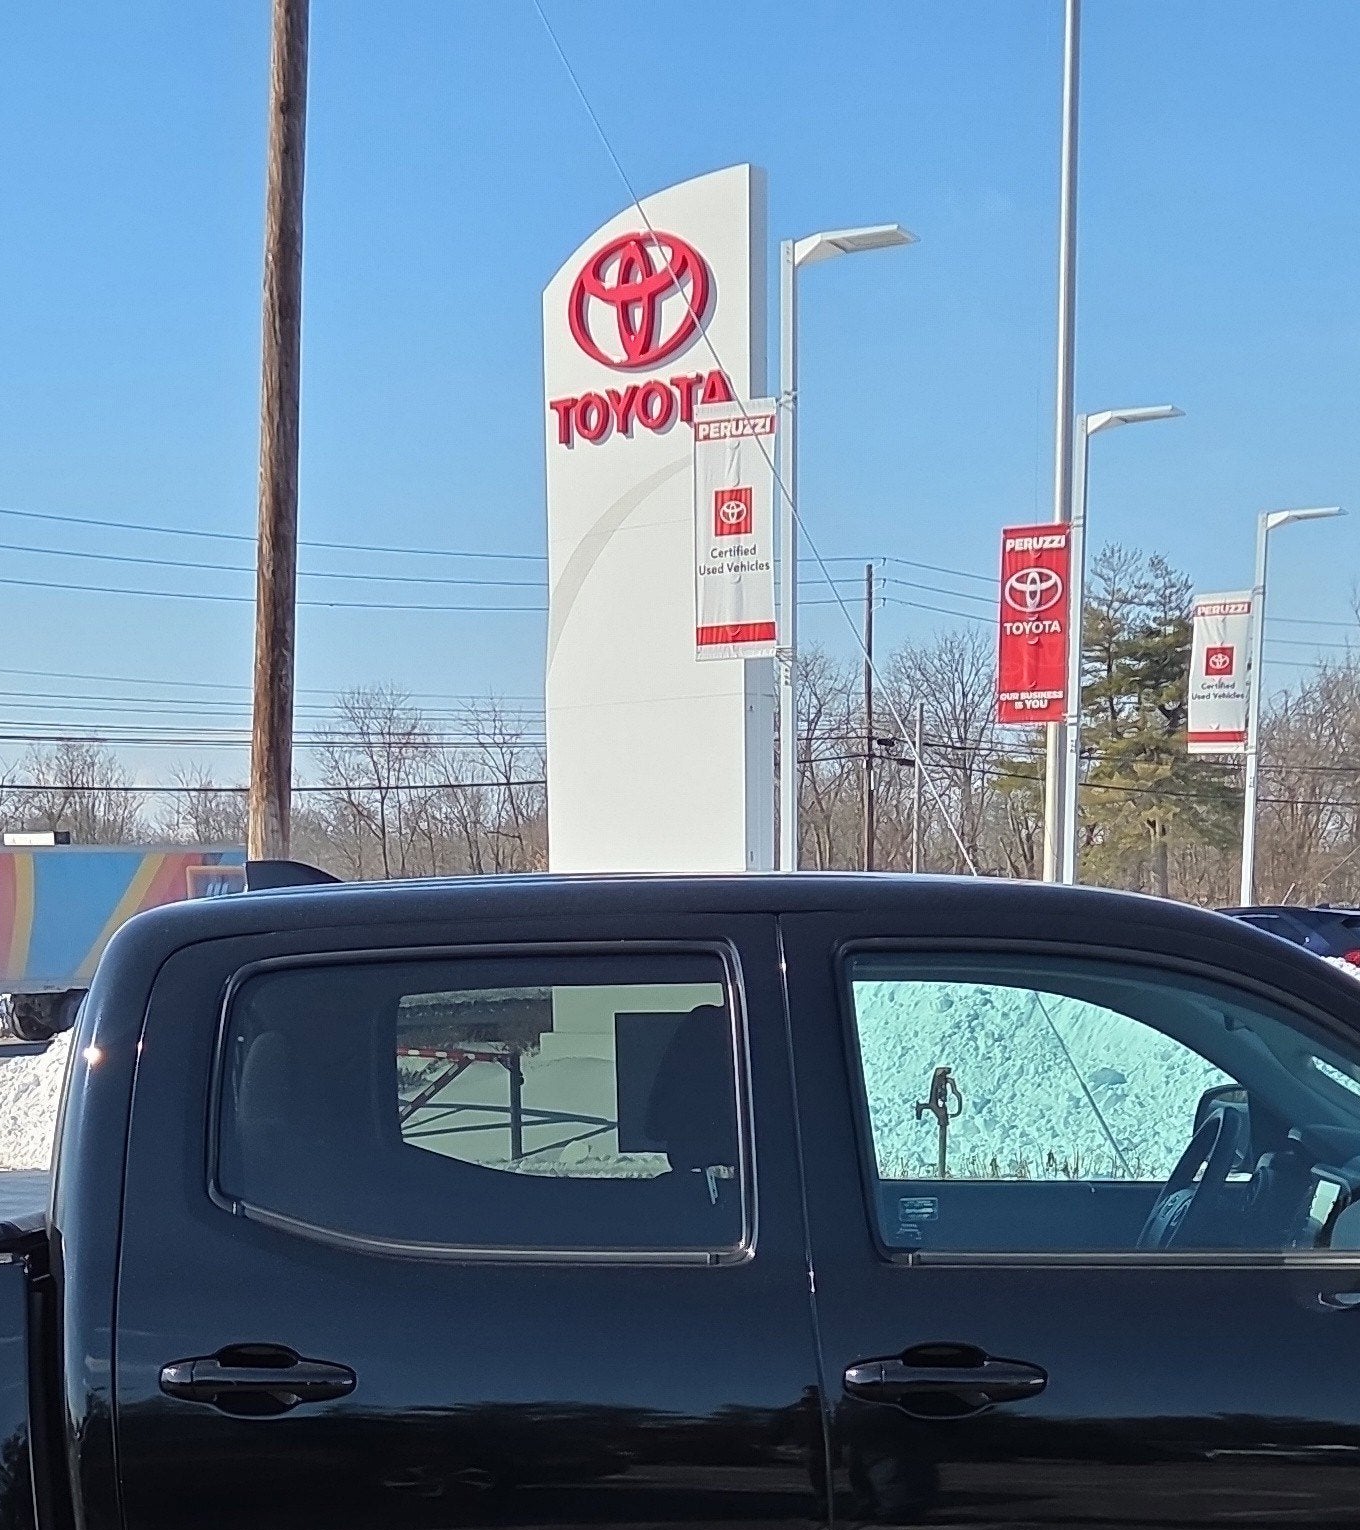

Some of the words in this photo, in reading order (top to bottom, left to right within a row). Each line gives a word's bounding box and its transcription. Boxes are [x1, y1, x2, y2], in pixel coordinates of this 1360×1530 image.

[550, 370, 734, 445] TOYOTA
[698, 416, 772, 441] PERUZZI
[1006, 534, 1066, 552] PERUZZI
[710, 544, 757, 559] Certified
[699, 563, 724, 575] Used
[726, 560, 771, 573] Vehicles
[1197, 603, 1249, 616] PERUZZI
[1004, 620, 1062, 636] TOYOTA
[1201, 681, 1236, 690] Certified
[1020, 690, 1064, 700] BUSINESS
[1191, 692, 1211, 700] Used
[1025, 699, 1049, 710] YOU
